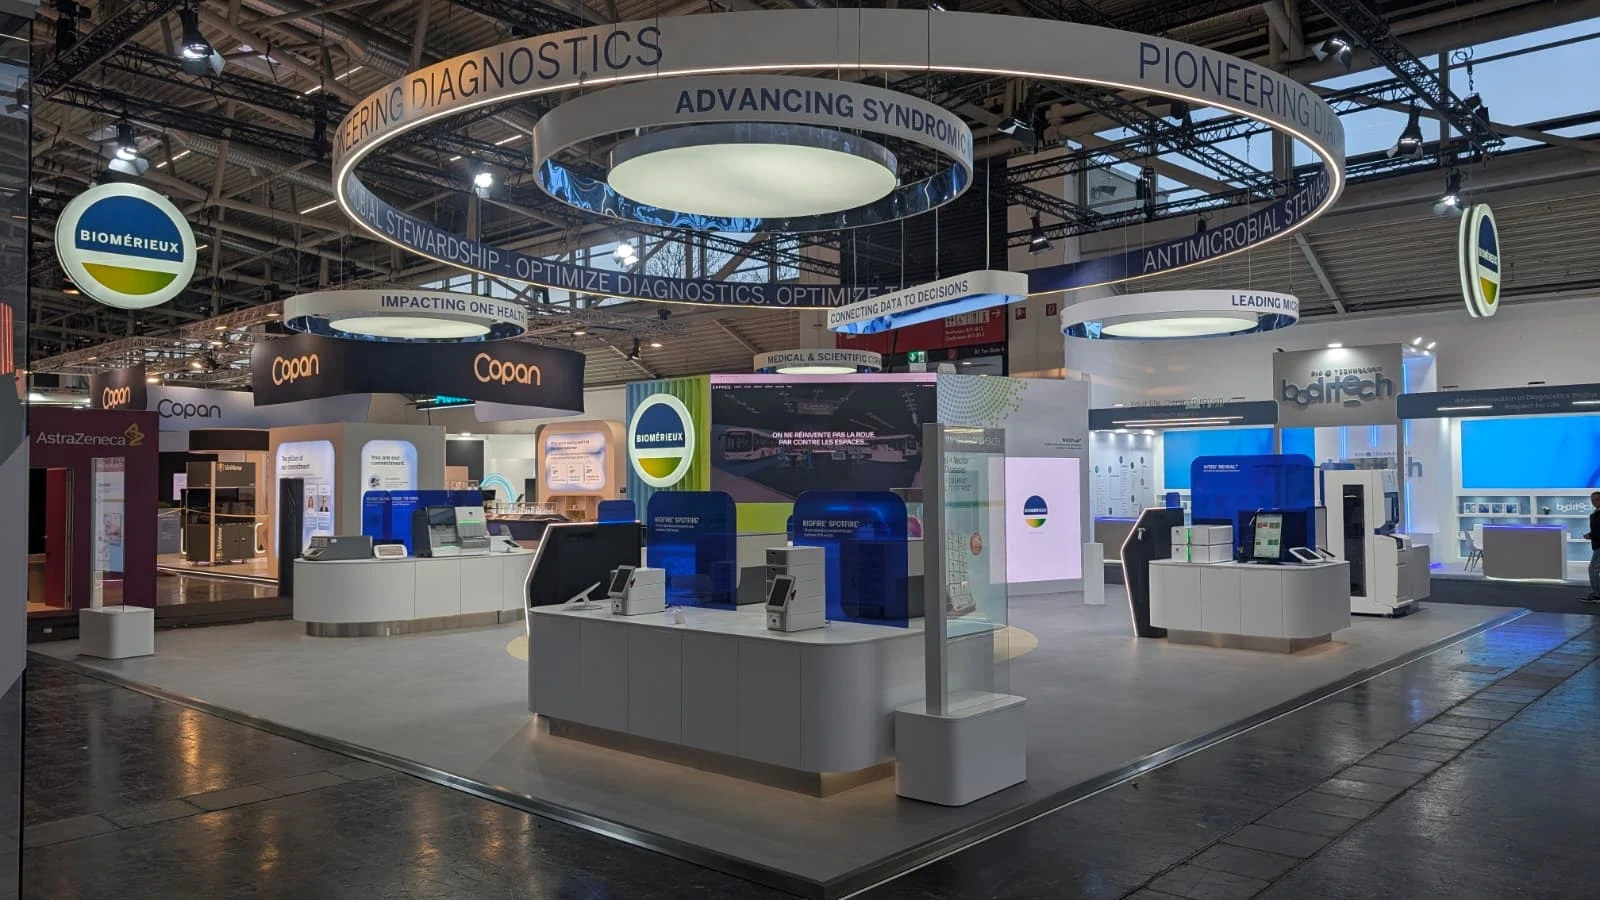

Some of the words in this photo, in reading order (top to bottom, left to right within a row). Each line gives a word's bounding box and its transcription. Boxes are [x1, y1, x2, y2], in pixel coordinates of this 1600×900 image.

[412, 27, 662, 112] DIAGNOSTICS
[1140, 42, 1309, 128] PIONEERING
[676, 88, 853, 118] ADVANCING
[863, 98, 965, 154] SYNDROMIC
[80, 229, 179, 253] BIOMÉRIEUX
[1144, 208, 1281, 273] ANTIMICROBIAL
[386, 210, 500, 271] STEWARDSHIP
[516, 258, 610, 293] OPTIMIZE
[618, 276, 770, 305] DIAGNOSTICS.
[381, 295, 466, 311] IMPACTING
[470, 301, 494, 315] ONE
[498, 304, 525, 323] HEALTH
[831, 303, 879, 324] CONNECTING
[881, 298, 902, 312] DATA
[904, 294, 916, 306] TO
[918, 280, 968, 303] DECISIONS
[1232, 295, 1281, 309] LEADING
[272, 353, 319, 386] Copan
[474, 352, 541, 386] Copan
[767, 354, 805, 364] MEDICAL
[807, 354, 815, 362] &
[817, 353, 867, 363] SCIENTIFIC
[103, 386, 130, 409] Copan
[158, 399, 221, 419] Copan
[37, 431, 126, 446] AstraZeneca
[636, 430, 683, 443] BIOMÉRIEUX
